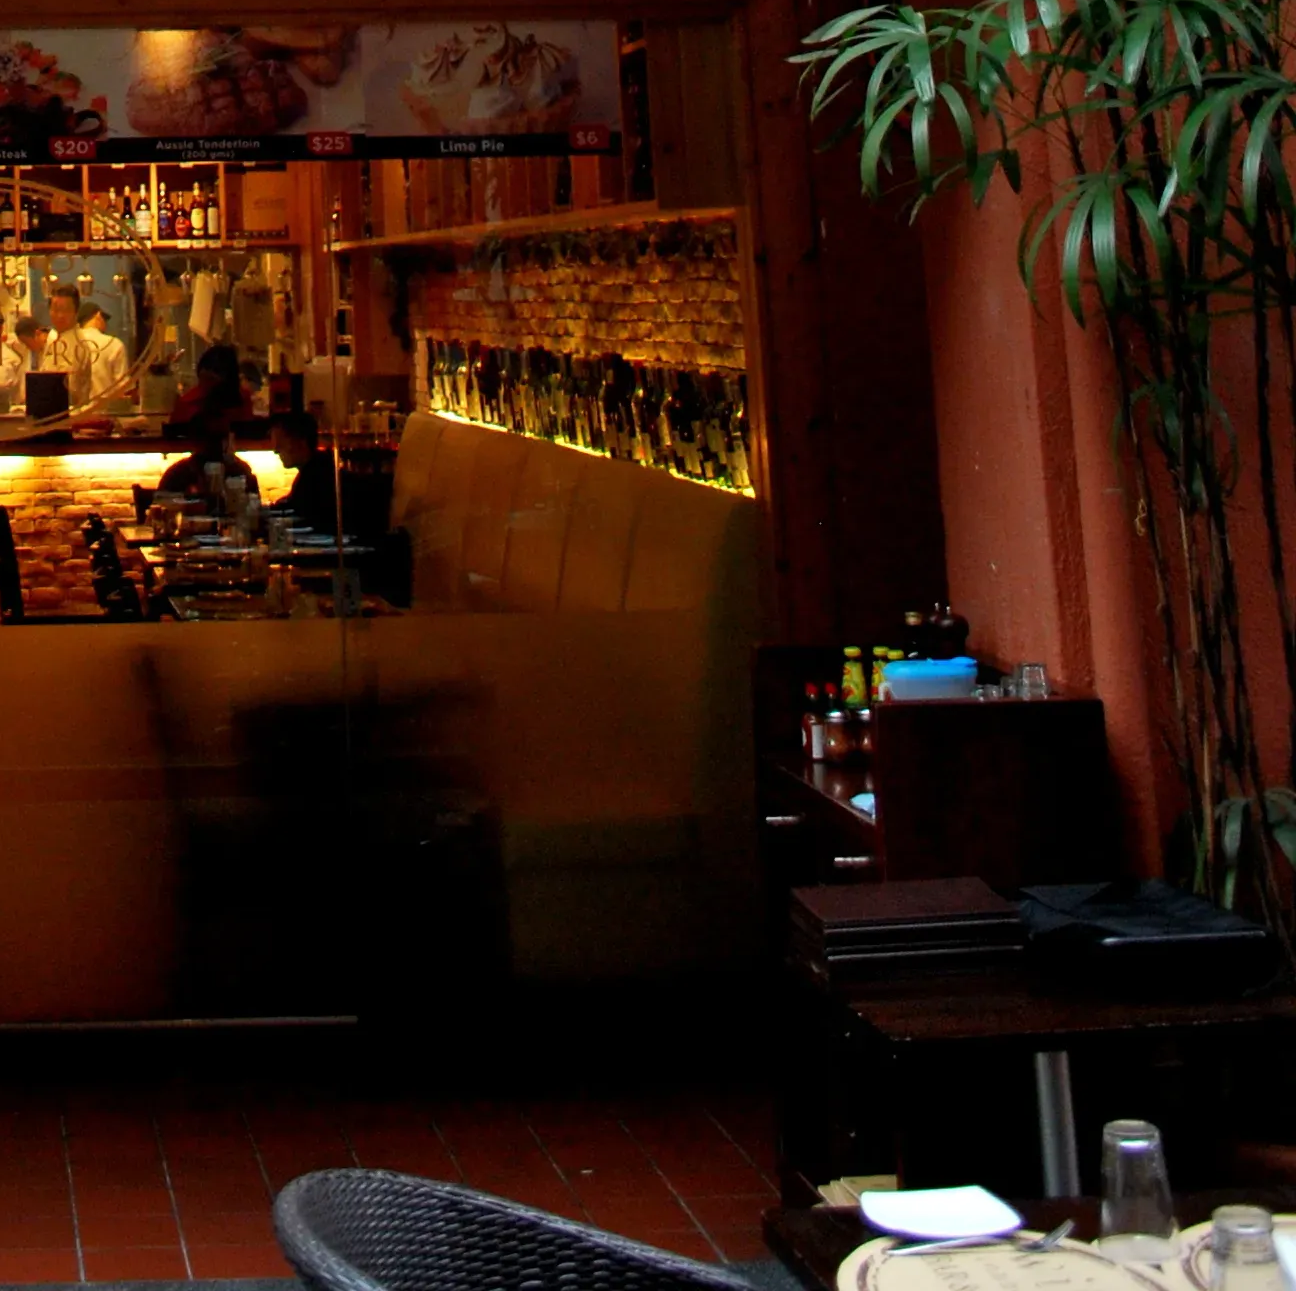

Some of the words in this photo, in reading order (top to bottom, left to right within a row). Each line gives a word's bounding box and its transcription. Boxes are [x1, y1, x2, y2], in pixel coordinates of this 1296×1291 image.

[156, 139, 194, 151] Aussie
[198, 138, 260, 150] Tenderloin
[440, 140, 476, 153] Lime
[482, 139, 505, 152] Pie
